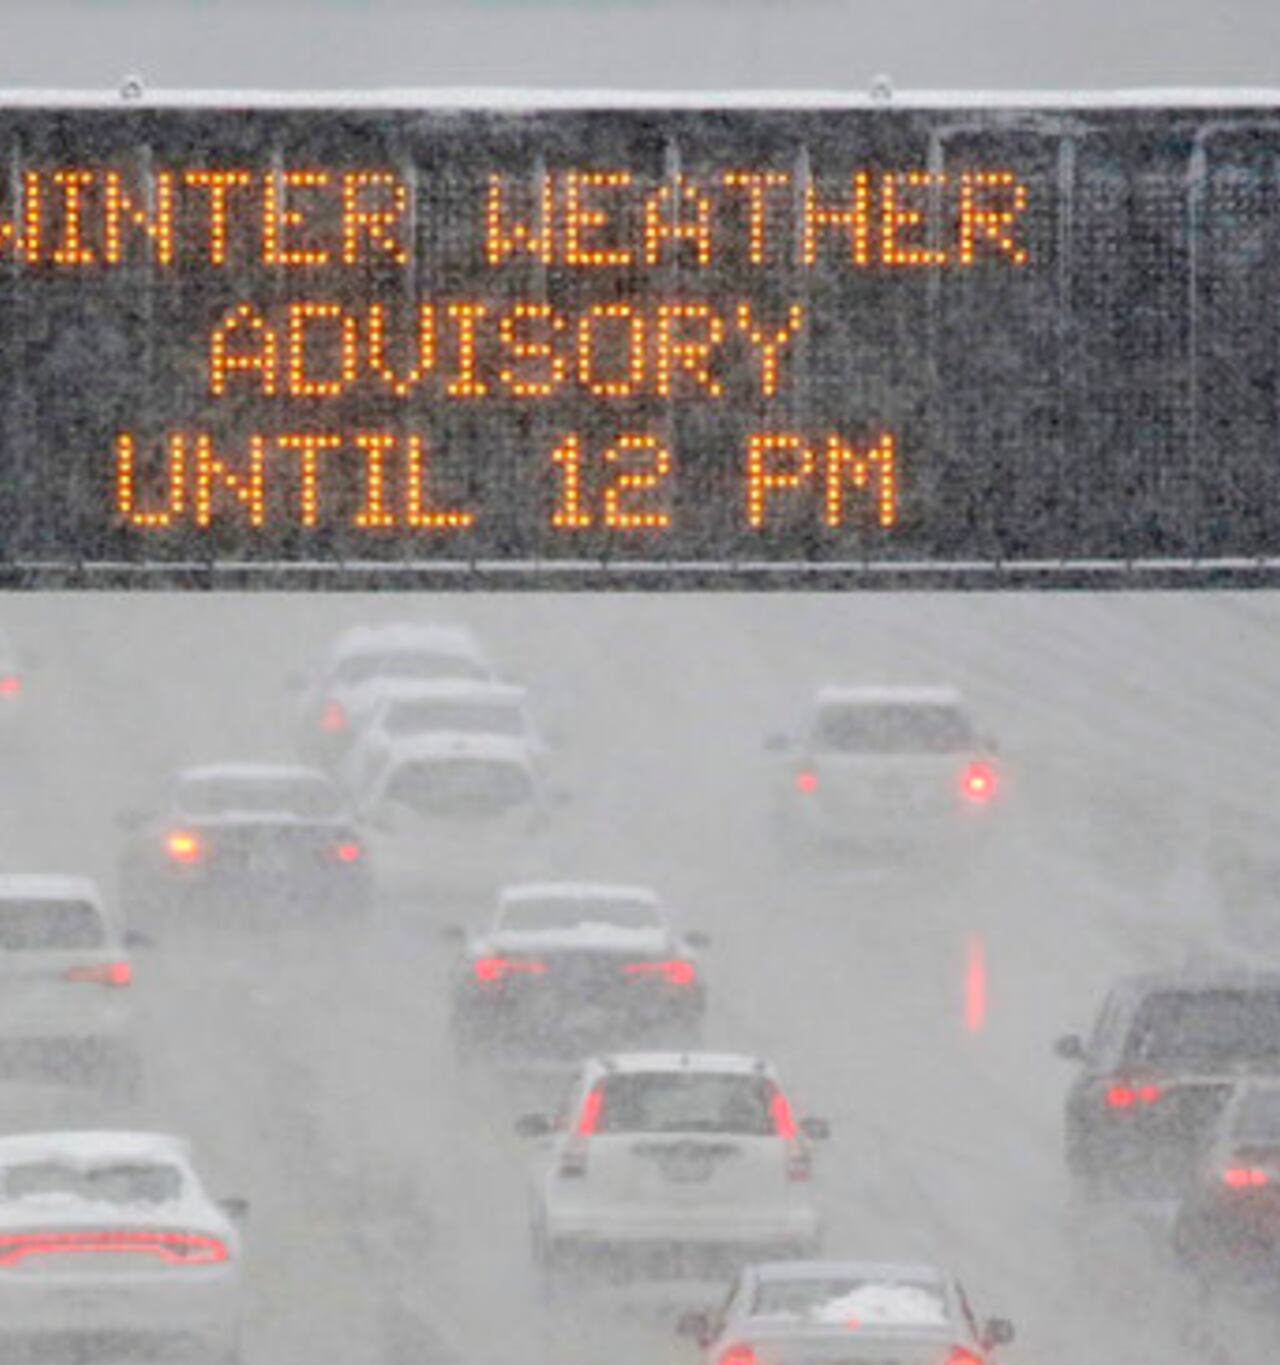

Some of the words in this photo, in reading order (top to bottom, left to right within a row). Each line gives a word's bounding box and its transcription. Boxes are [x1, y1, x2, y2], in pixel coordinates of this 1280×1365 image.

[482, 169, 1028, 268] WEATHER
[207, 300, 805, 400] ADVISORY
[114, 430, 477, 531] UNTIL
[548, 431, 674, 531] 12
[742, 431, 899, 531] PM
